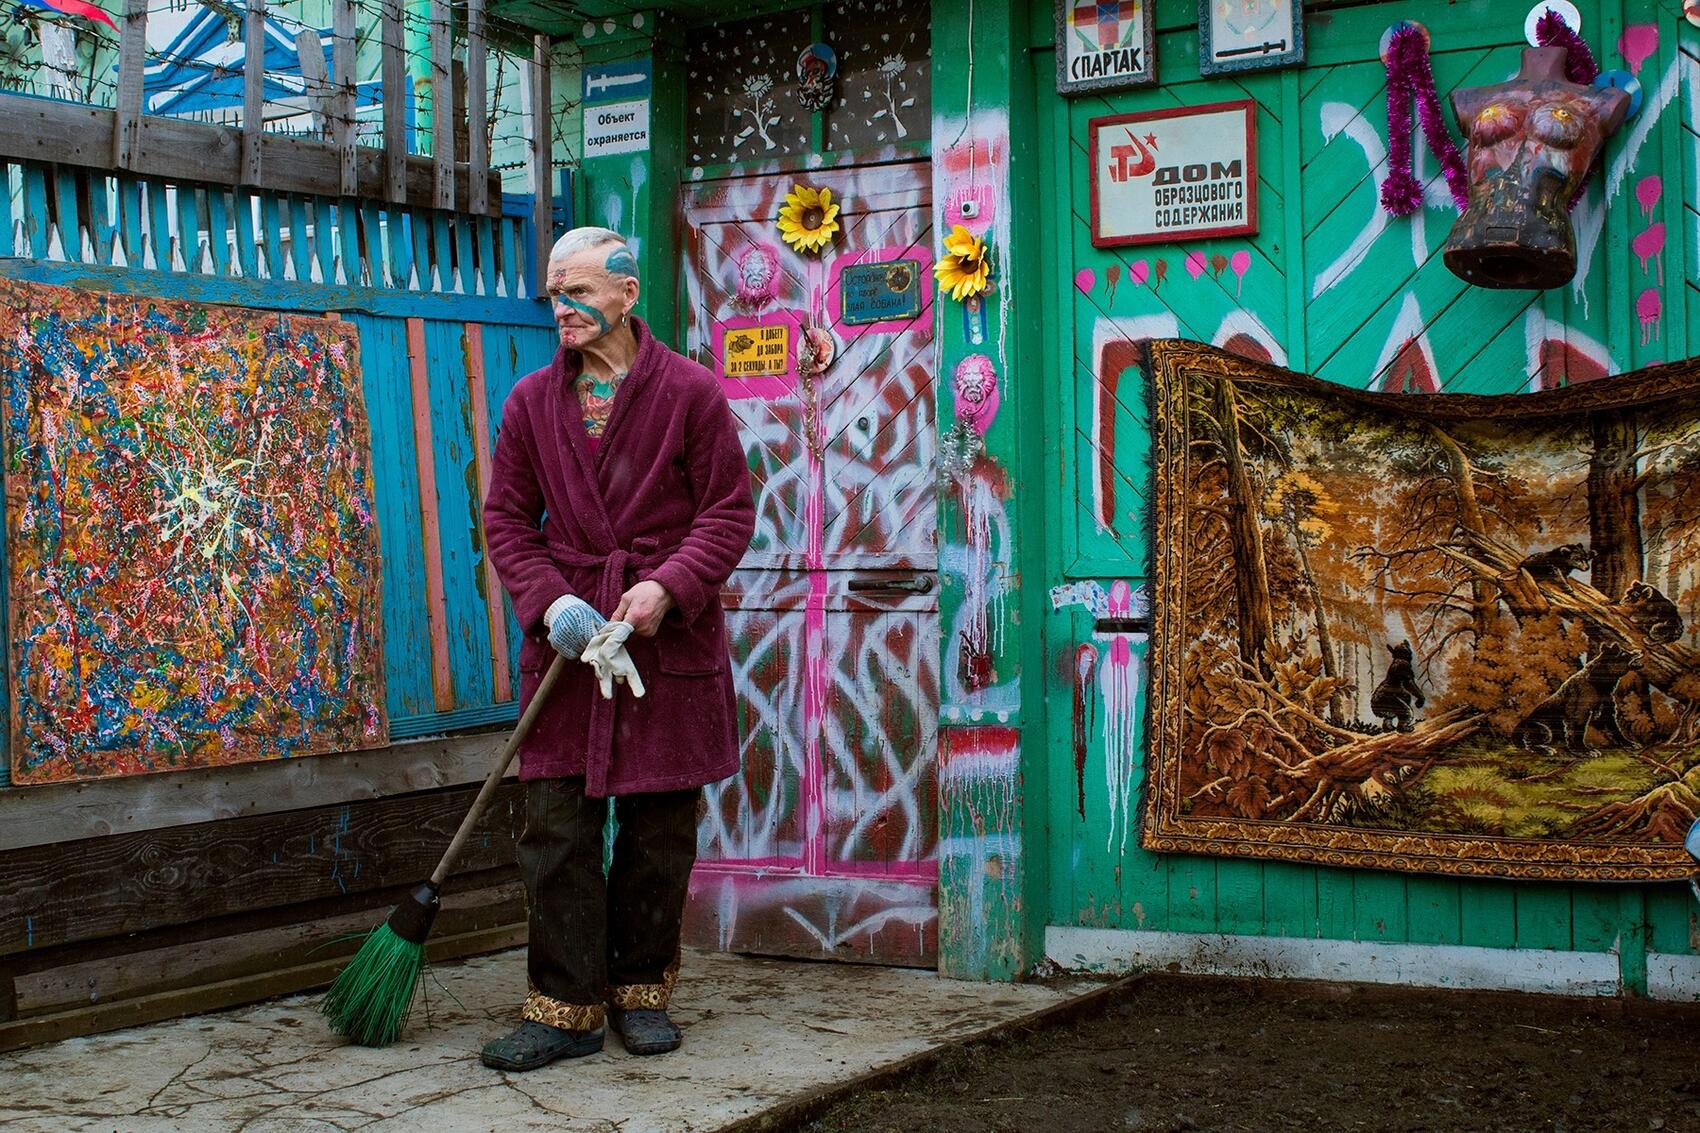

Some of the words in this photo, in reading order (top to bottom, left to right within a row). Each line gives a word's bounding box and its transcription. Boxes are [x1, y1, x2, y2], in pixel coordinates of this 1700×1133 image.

[1071, 48, 1142, 80] СПАРТАК
[598, 112, 635, 125] Объект
[587, 131, 646, 147] охраняется
[1152, 160, 1242, 187] ДОМ
[1154, 181, 1242, 206] ОБРАЗЦОВОГО
[1155, 202, 1243, 228] СОДЕРЖАНИЯ
[757, 344, 763, 356] ДО
[765, 343, 783, 355] ЗАБОРА
[731, 361, 737, 372] ЗА
[738, 361, 742, 372] 2
